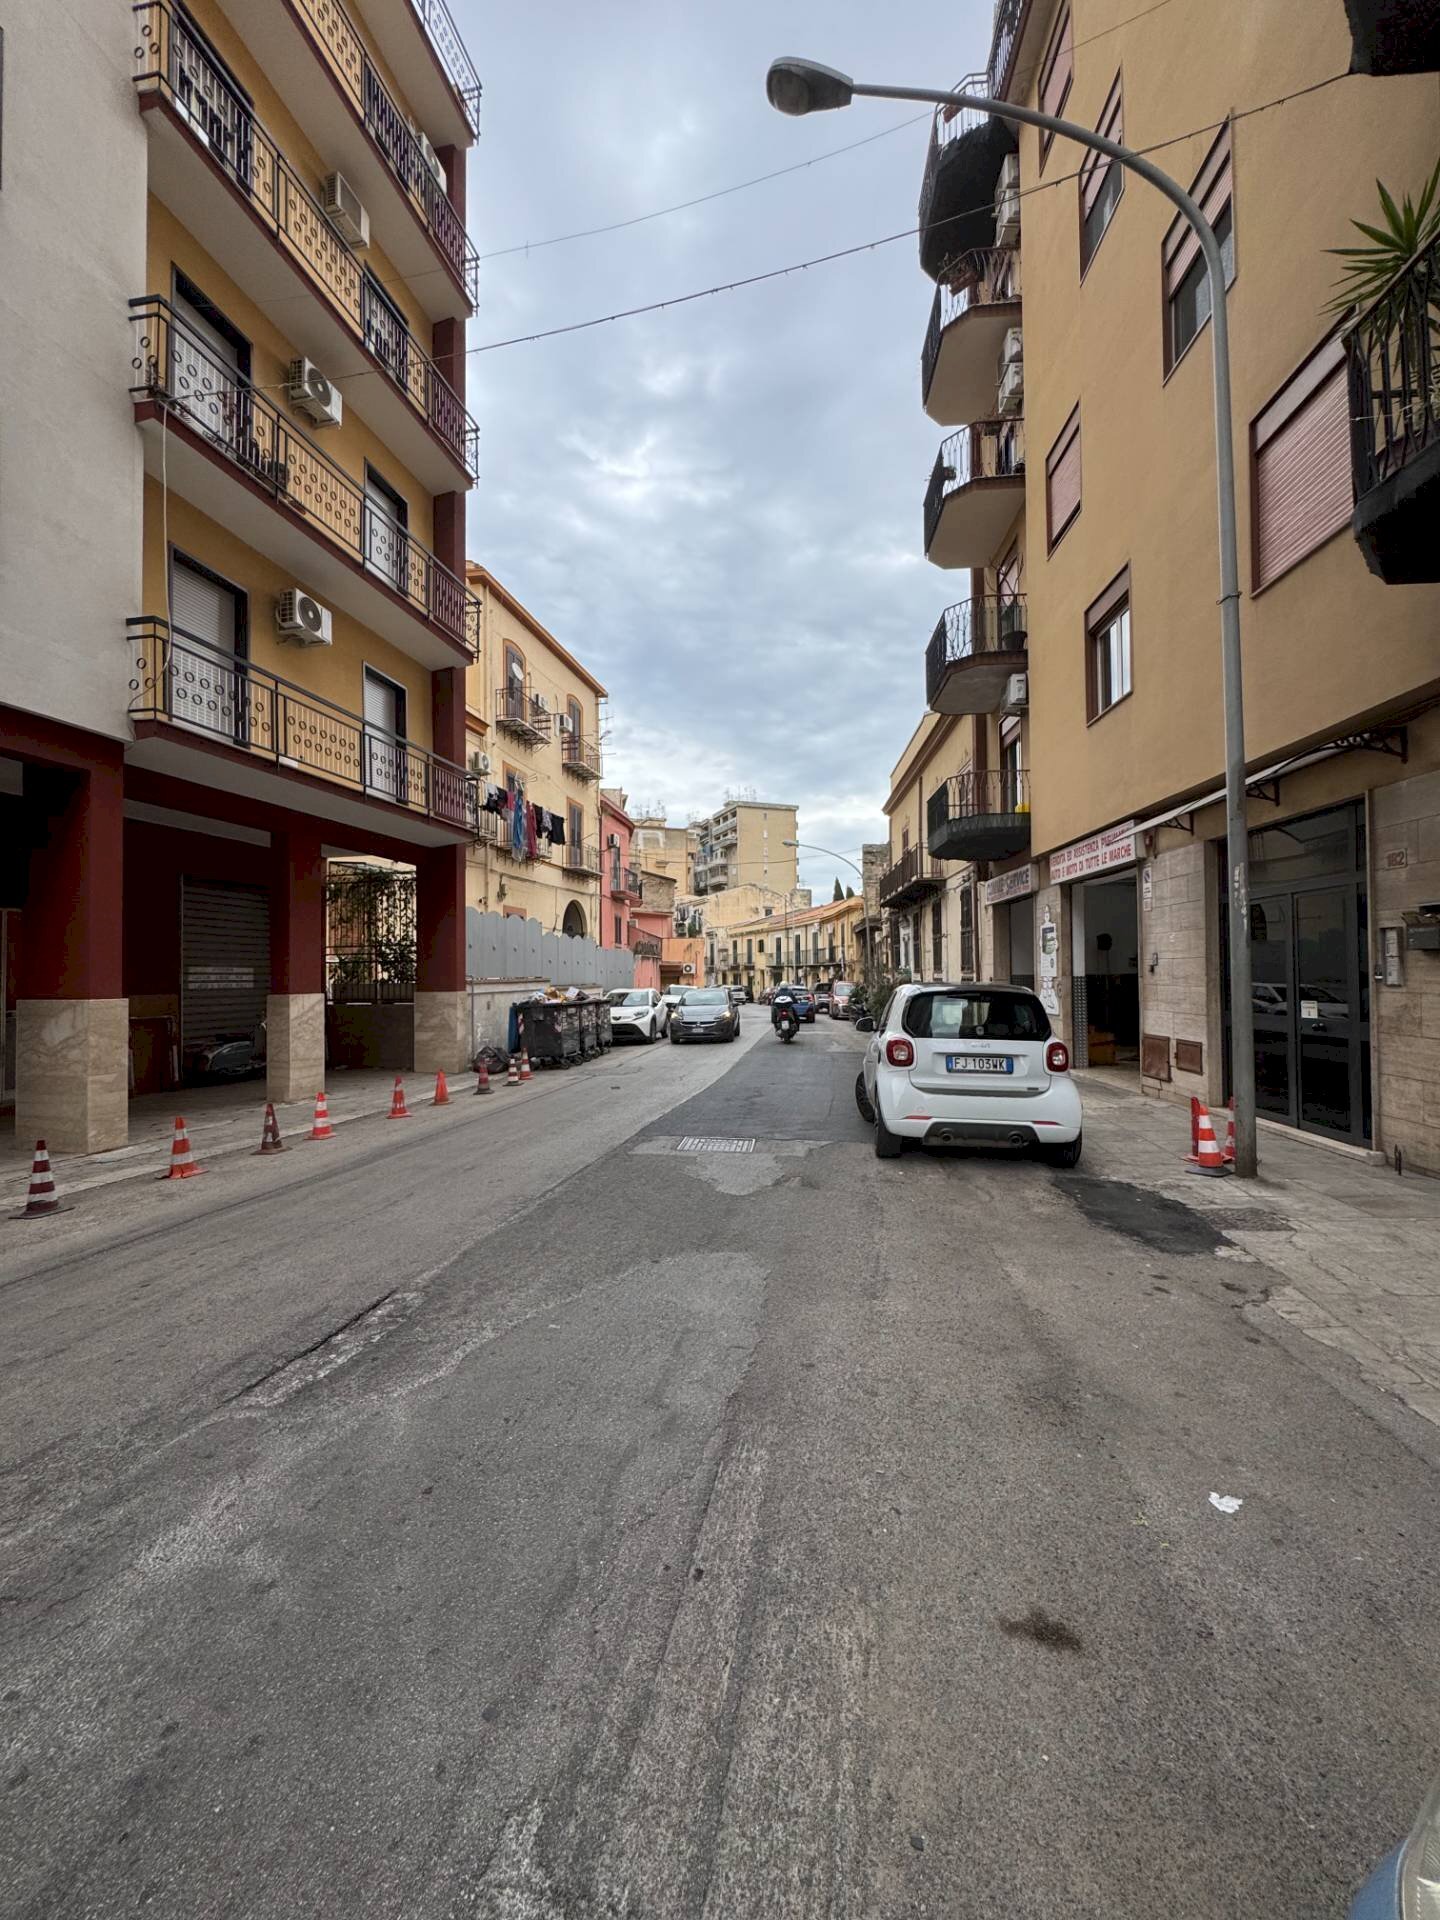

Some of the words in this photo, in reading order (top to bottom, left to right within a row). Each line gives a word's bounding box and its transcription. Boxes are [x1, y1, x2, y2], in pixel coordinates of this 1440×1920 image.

[1073, 839, 1100, 858] ASSISTENZA
[1085, 854, 1100, 869] TUTTE
[1101, 851, 1108, 865] LE
[1108, 843, 1132, 861] MARCHE
